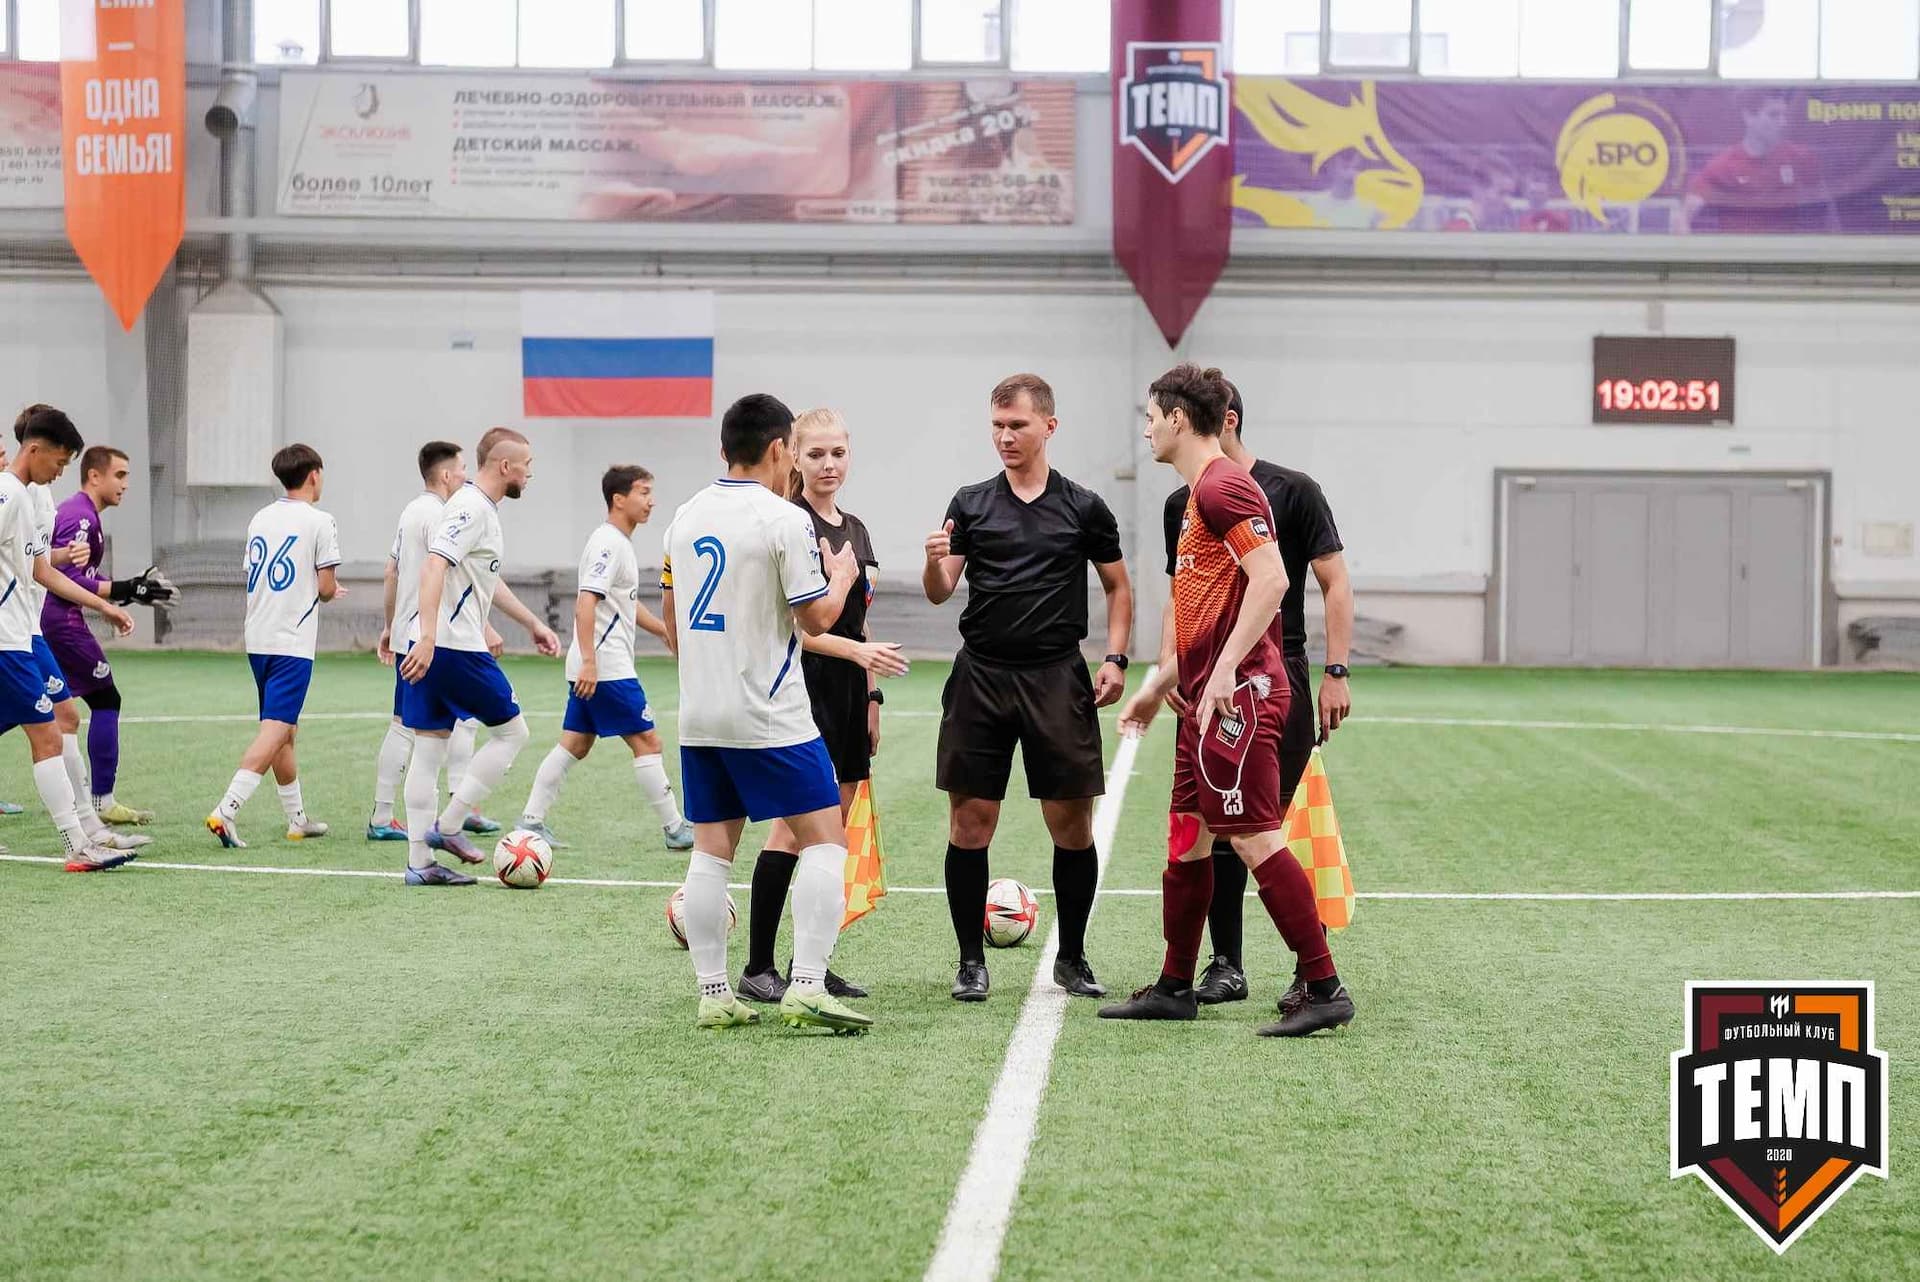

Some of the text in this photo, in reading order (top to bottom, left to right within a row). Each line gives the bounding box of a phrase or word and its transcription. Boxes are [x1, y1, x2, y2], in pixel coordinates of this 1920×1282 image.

[86, 78, 160, 126] ОДНА
[1130, 81, 1219, 131] ТЕМП
[1807, 98, 1882, 125] Время
[76, 133, 172, 176] СЕМЬЯ!
[453, 135, 543, 153] ДЕТСКИЙ
[1587, 142, 1657, 167] .БРО
[292, 172, 361, 192] более
[1598, 379, 1720, 411] 19:02:51
[248, 536, 299, 594] 96
[689, 535, 727, 633] 2
[1221, 789, 1245, 816] 23
